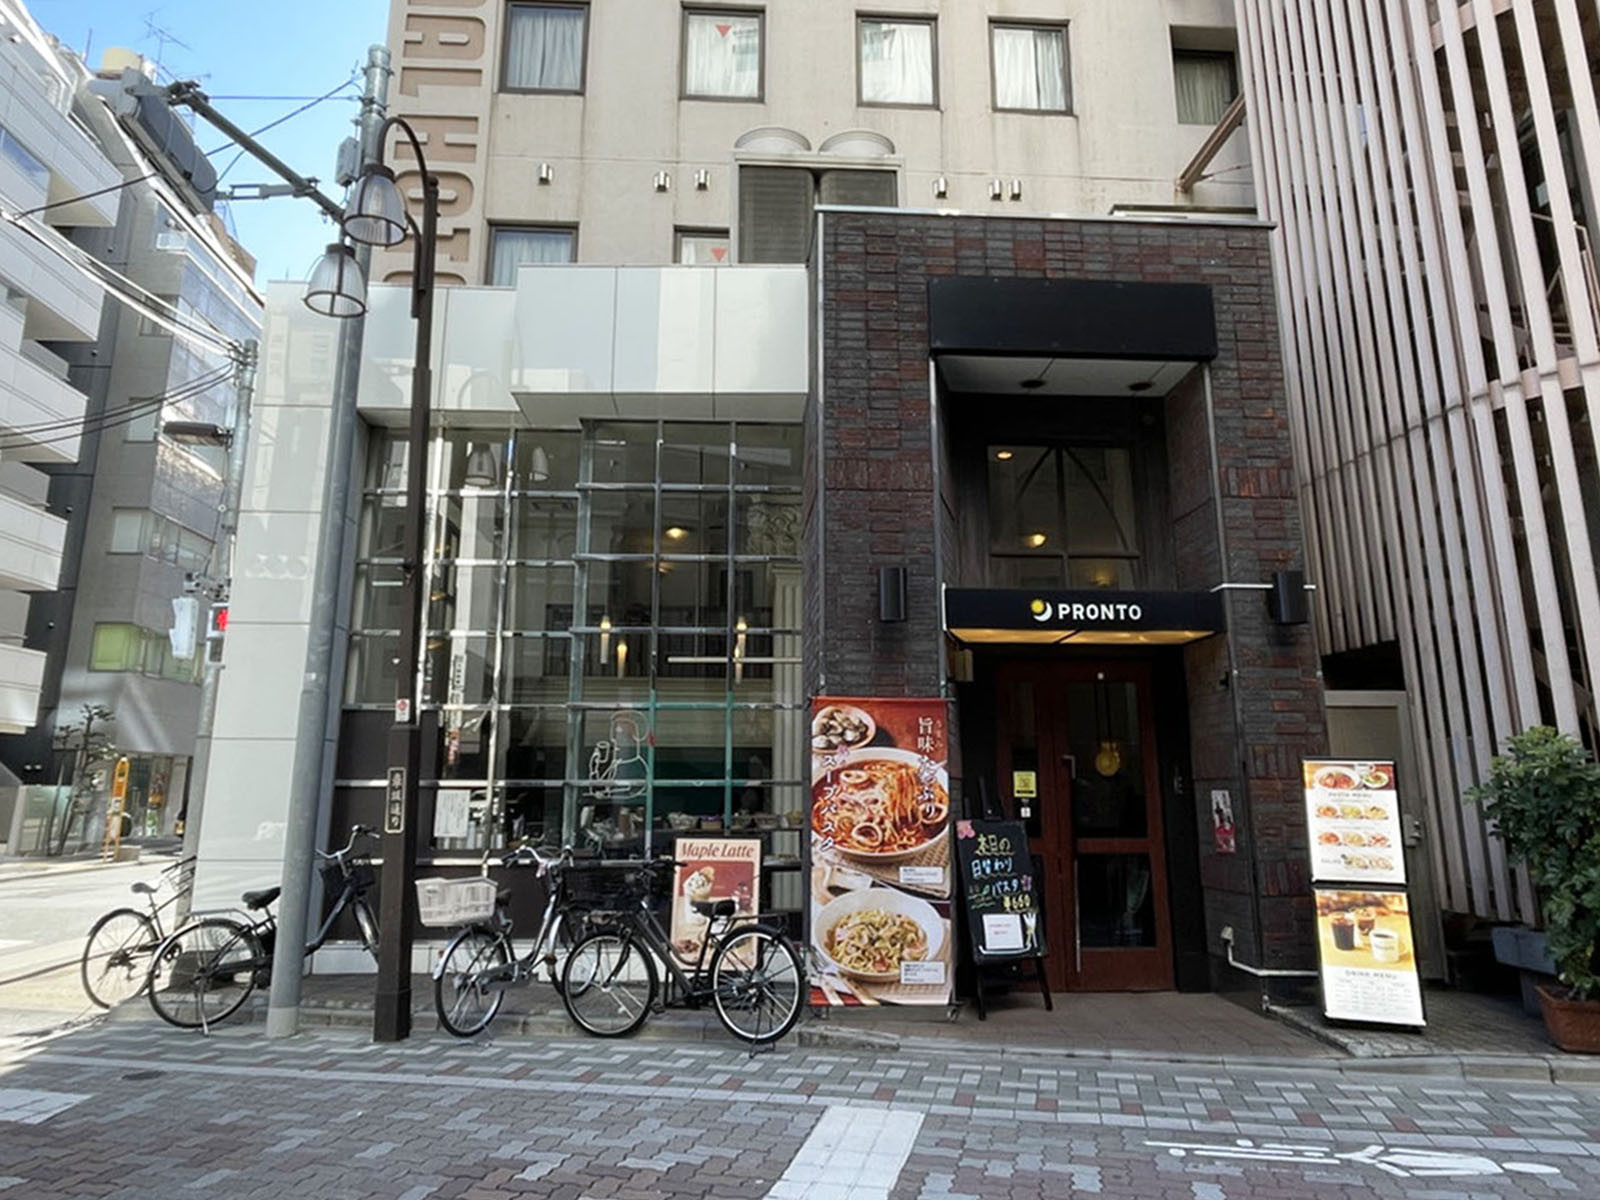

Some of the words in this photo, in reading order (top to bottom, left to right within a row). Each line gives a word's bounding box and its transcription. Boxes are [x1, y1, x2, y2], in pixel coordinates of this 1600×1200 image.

[399, 0, 487, 97] AL
[1057, 603, 1142, 620] PRONTO
[681, 842, 720, 859] Maple
[721, 843, 755, 858] Latte
[976, 833, 1012, 853] 本日の
[992, 879, 1019, 897] パスタ
